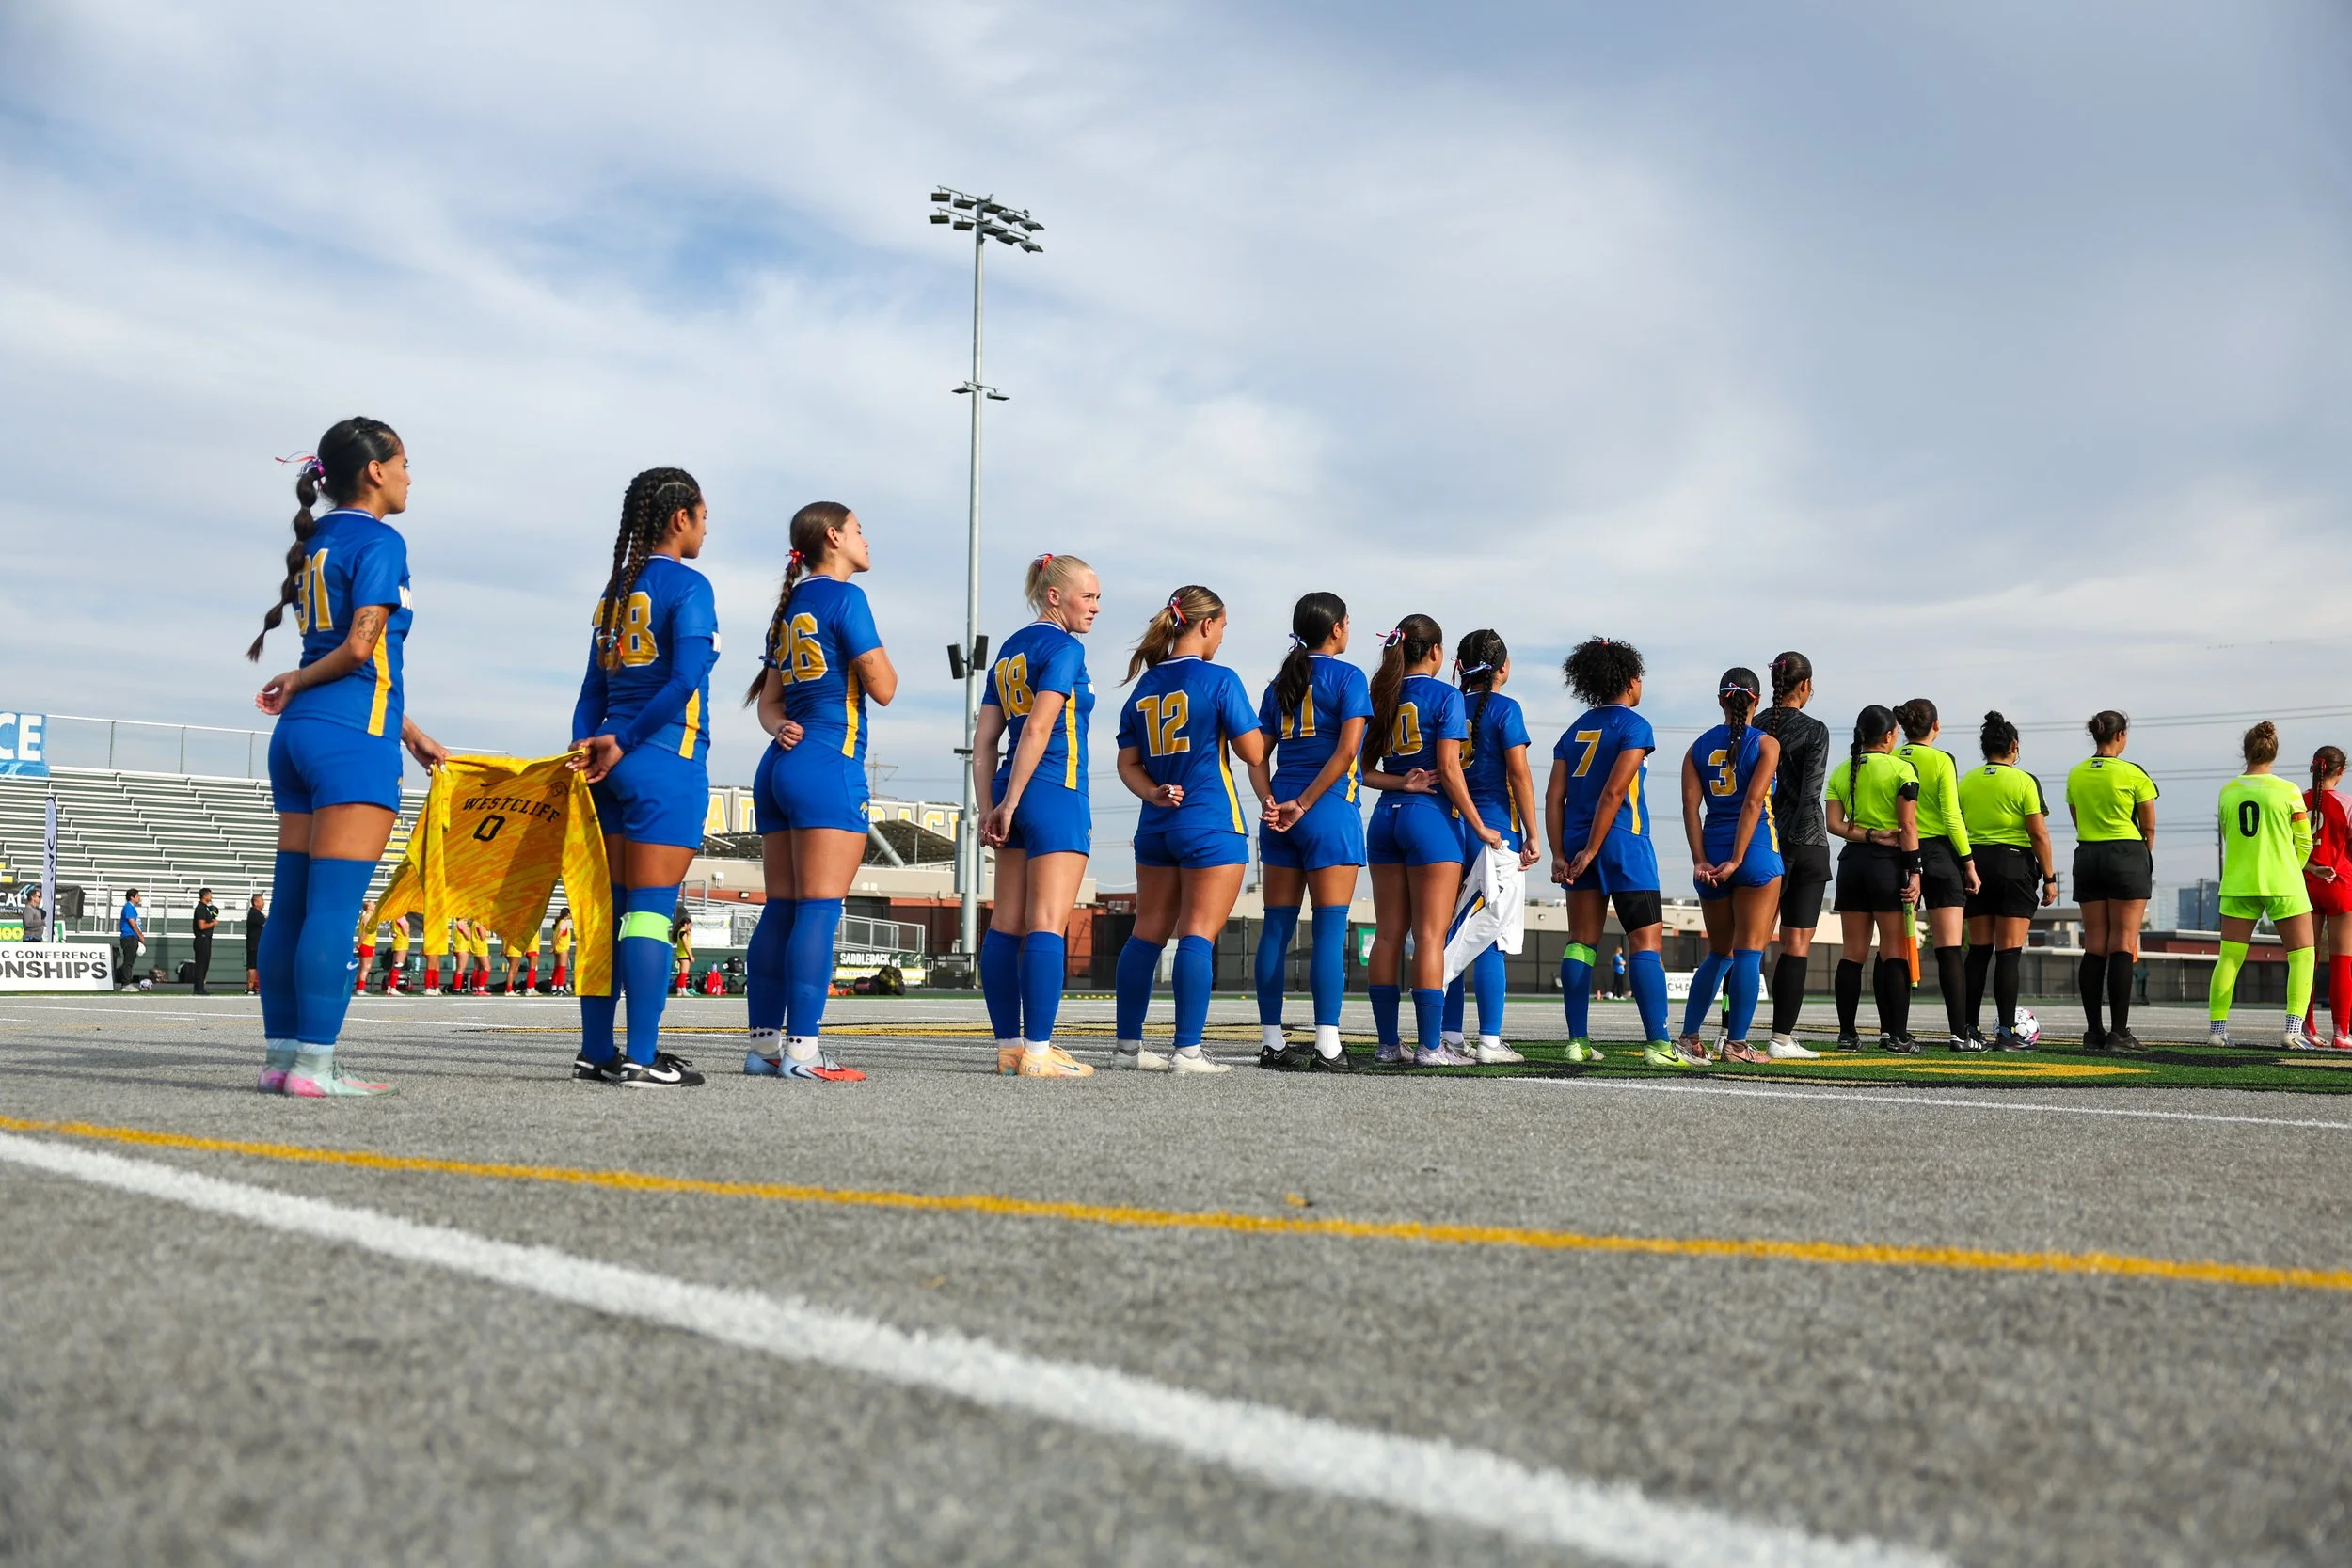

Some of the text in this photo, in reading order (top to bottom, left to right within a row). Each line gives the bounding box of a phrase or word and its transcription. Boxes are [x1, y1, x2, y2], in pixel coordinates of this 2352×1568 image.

[769, 612, 829, 685] 26
[994, 652, 1036, 721] 18
[1136, 689, 1190, 757] 12
[1382, 701, 1423, 757] 0
[1571, 728, 1603, 777] 7
[1708, 749, 1738, 797] 3
[462, 798, 561, 823] WESTCLIFF
[472, 814, 506, 842] 0
[2238, 800, 2260, 838] 0
[0, 960, 108, 979] NSHIPS
[15, 950, 106, 959] CONFERENCE
[840, 952, 891, 966] SADDLEBACK
